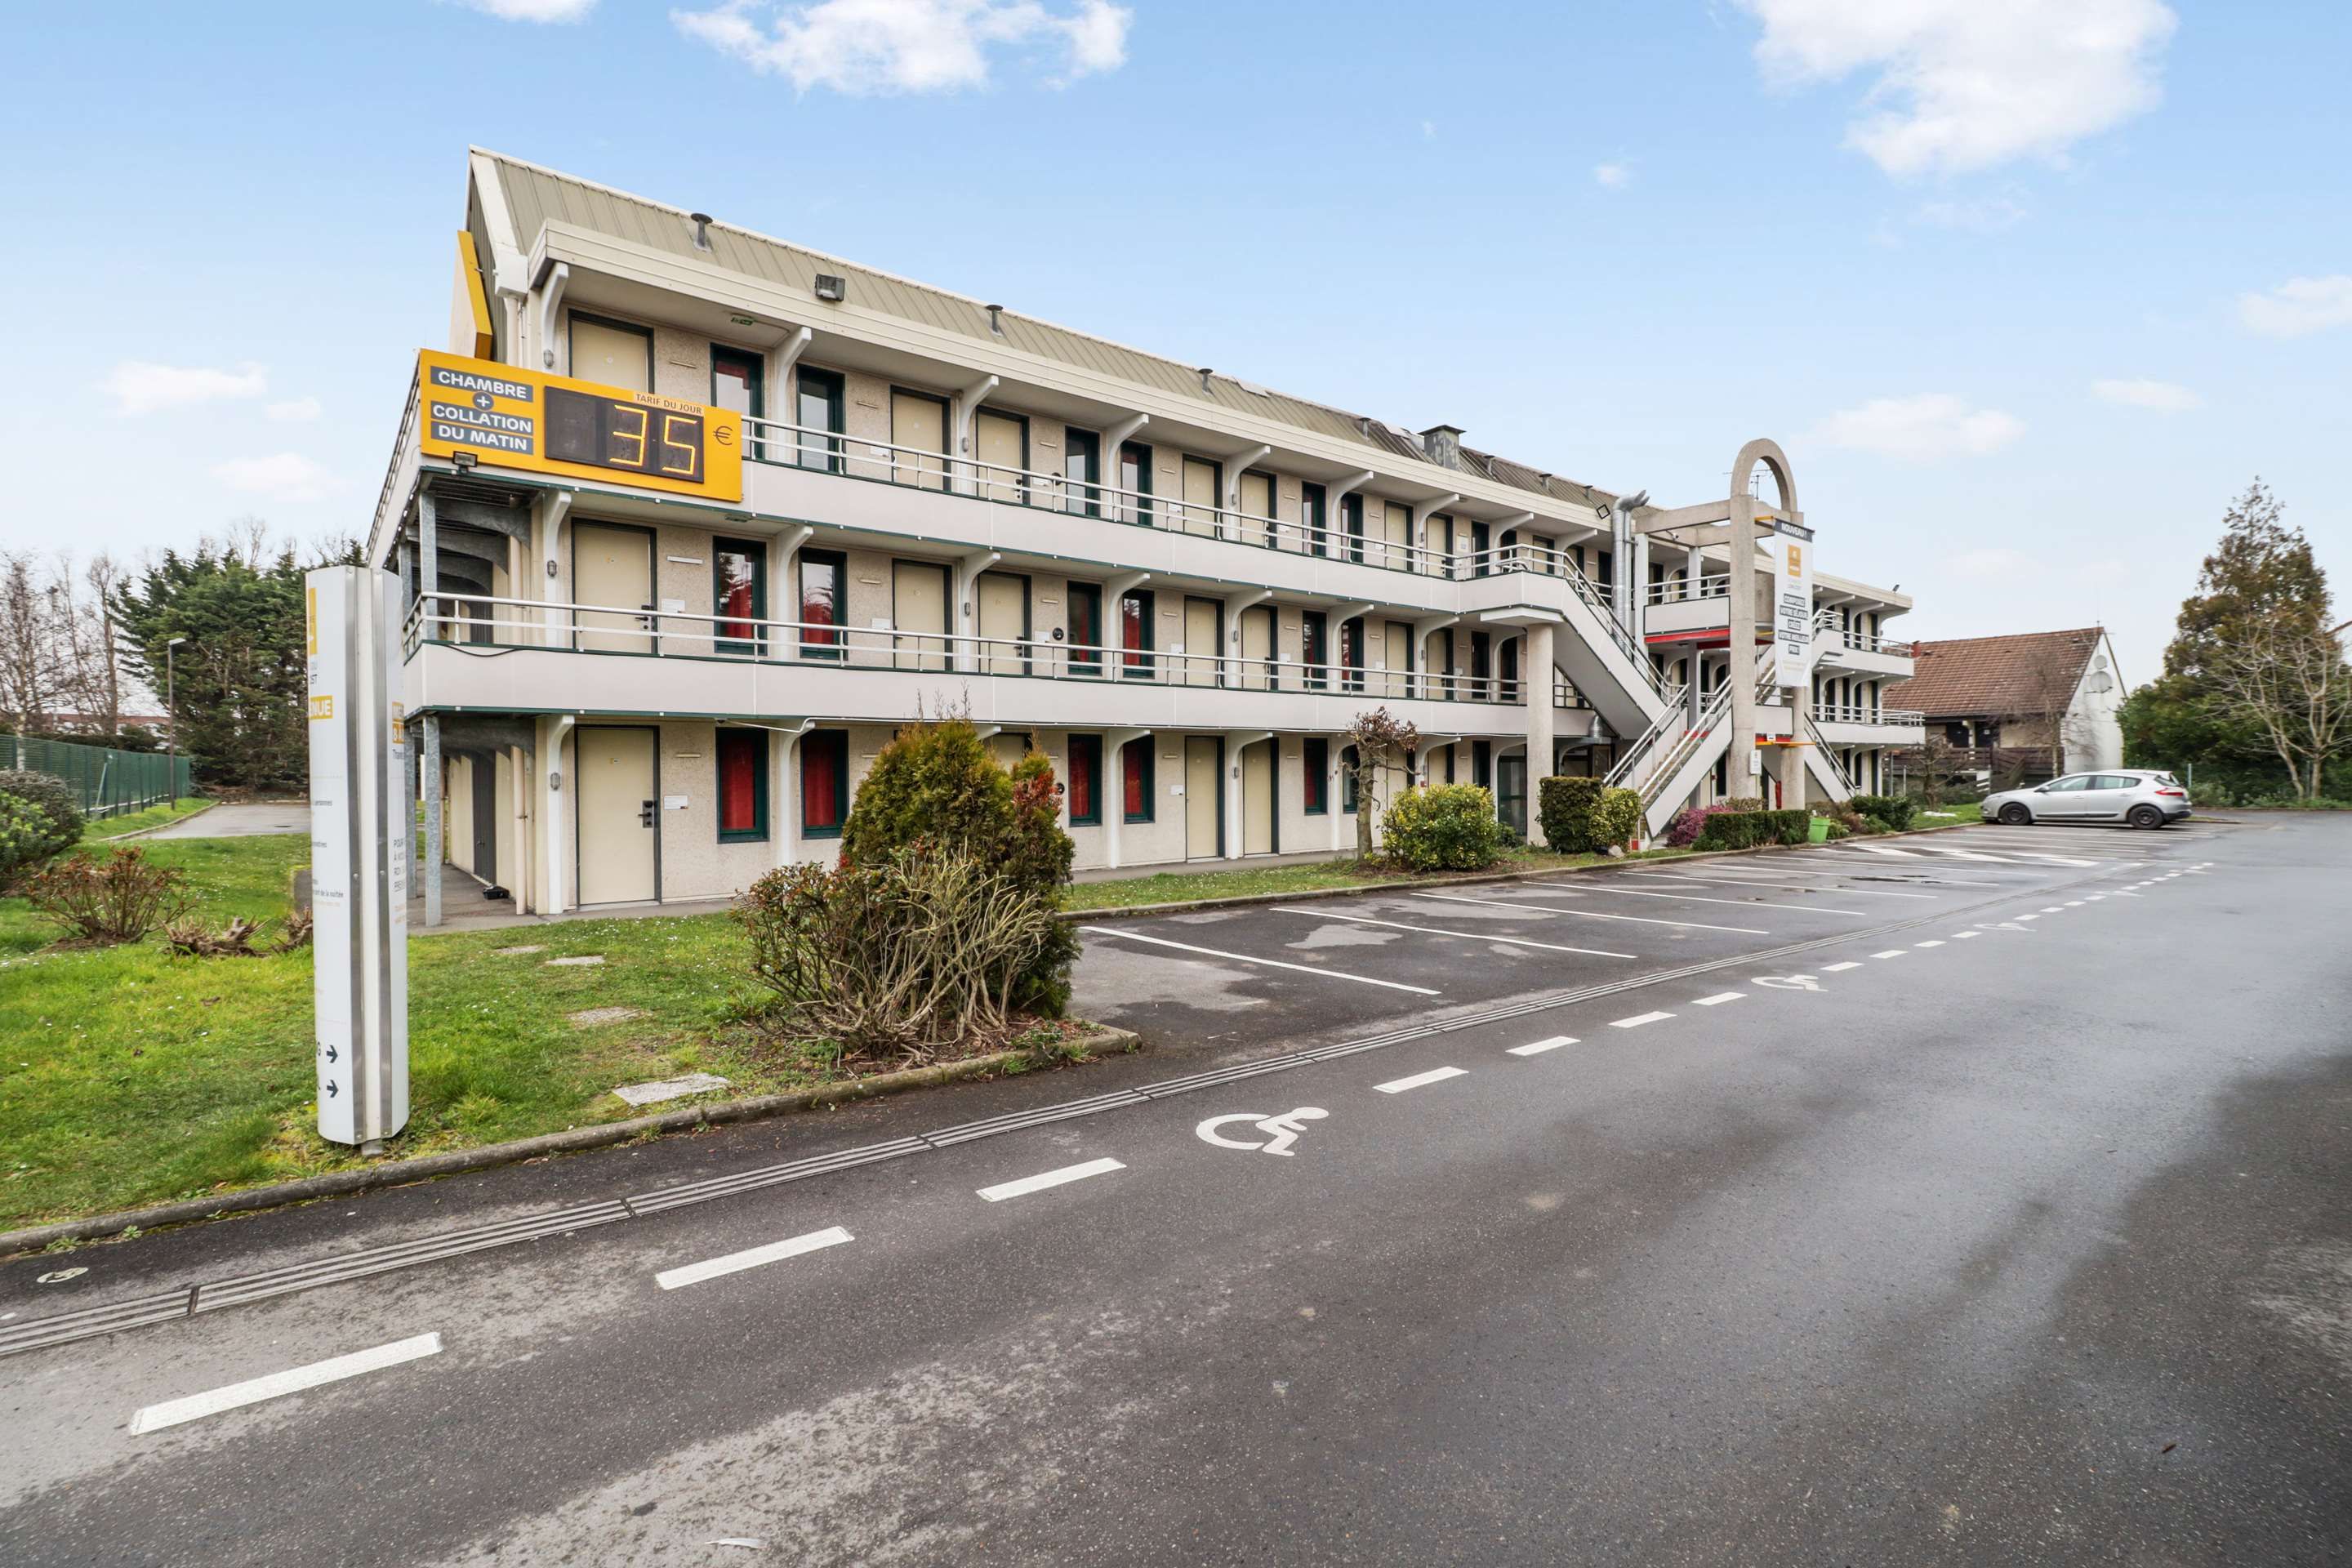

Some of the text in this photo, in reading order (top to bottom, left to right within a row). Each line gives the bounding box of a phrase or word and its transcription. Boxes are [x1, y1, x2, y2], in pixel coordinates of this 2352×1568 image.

[439, 372, 527, 399] CHAMBRE
[635, 394, 702, 414] TARIF DU JOUR
[433, 404, 532, 433] COLLATION
[439, 425, 527, 451] DU MATIN
